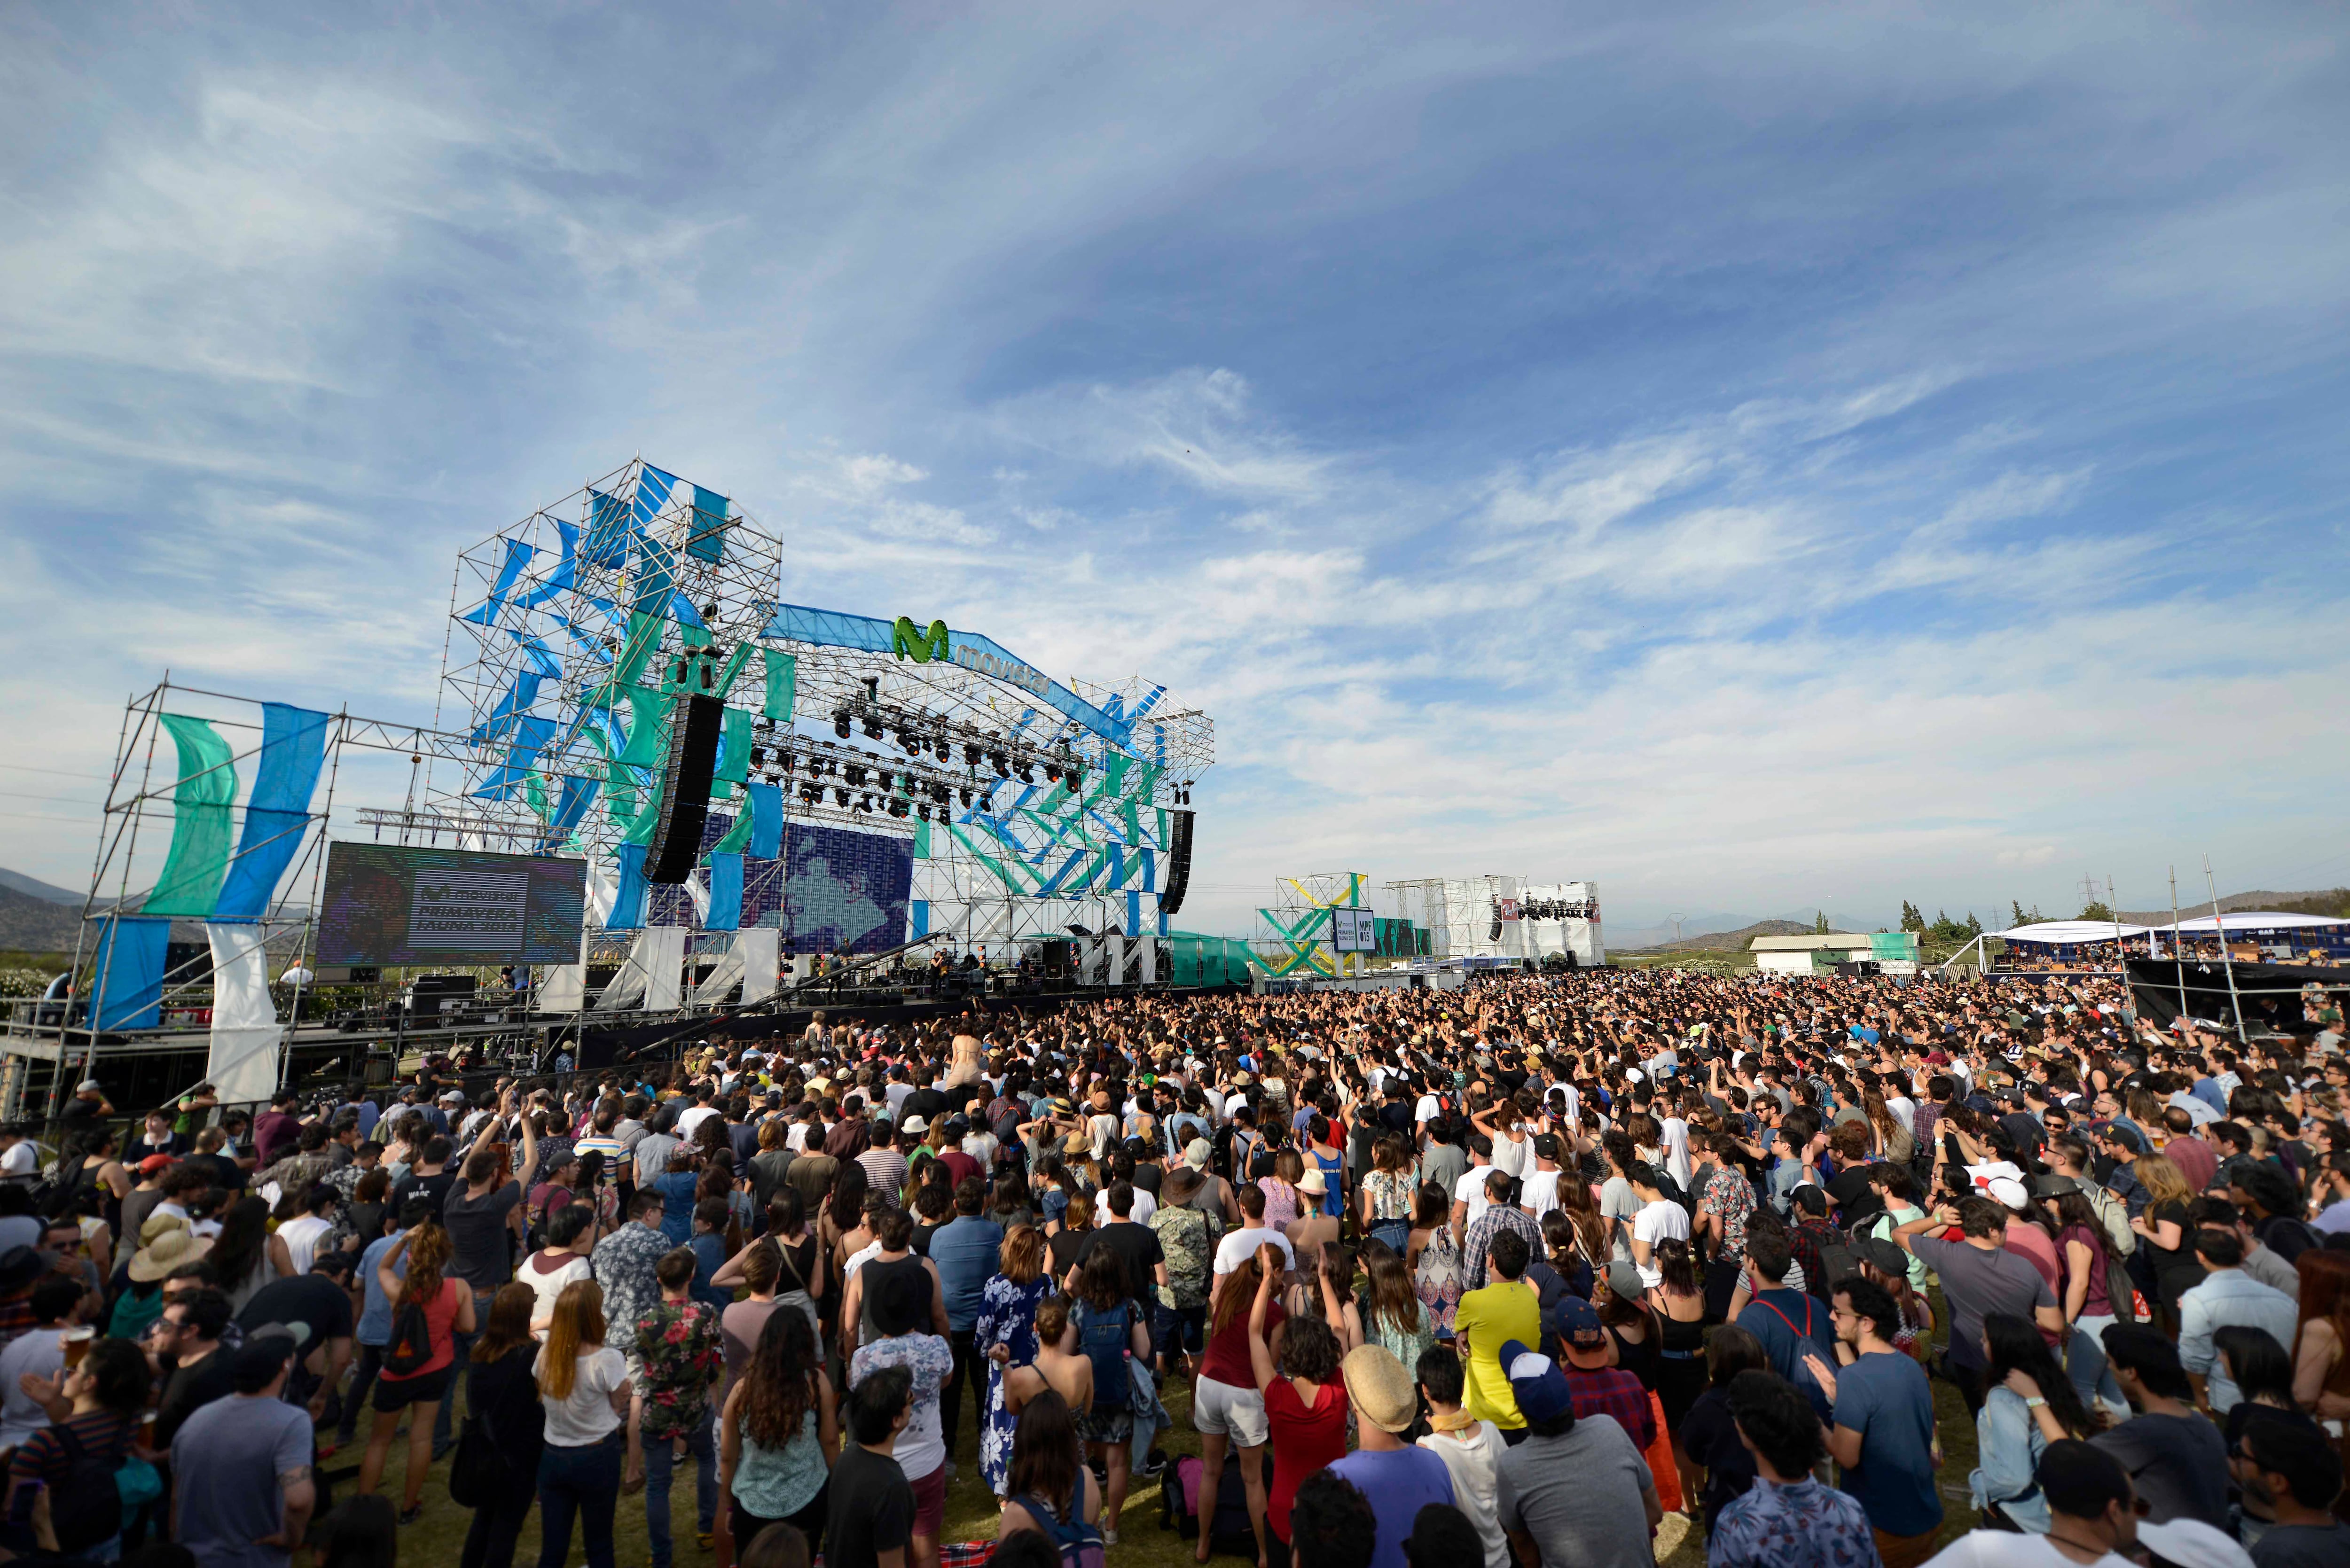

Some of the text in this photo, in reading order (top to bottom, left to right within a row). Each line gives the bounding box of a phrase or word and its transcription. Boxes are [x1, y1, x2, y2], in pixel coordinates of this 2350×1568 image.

[955, 644, 1052, 695] movistar
[454, 890, 519, 901] movistar
[418, 906, 518, 920] PRIMAVERA
[416, 920, 475, 931] FAUNA
[1359, 921, 1371, 931] MPF
